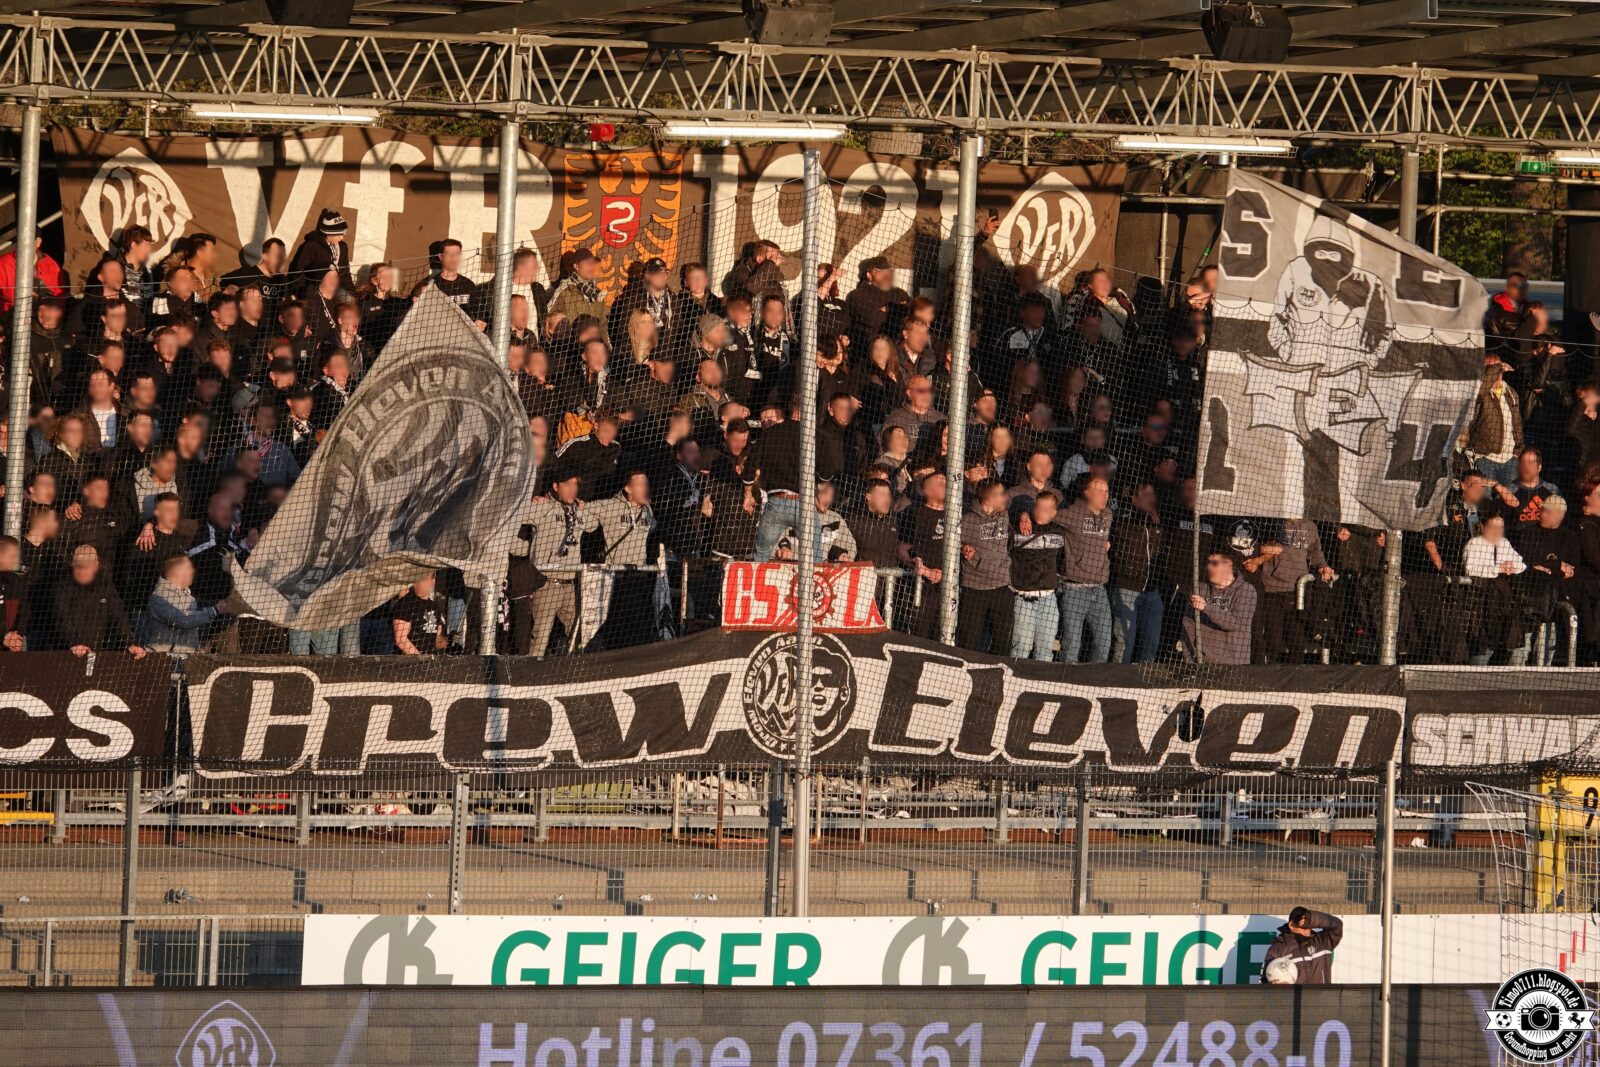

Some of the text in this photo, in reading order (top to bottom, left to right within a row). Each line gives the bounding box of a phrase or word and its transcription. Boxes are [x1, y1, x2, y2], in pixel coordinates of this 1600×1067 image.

[205, 135, 554, 290] VfR
[869, 645, 1404, 780] Eleven
[491, 929, 823, 985] GEIGER
[1021, 930, 1334, 985] GEIGE
[478, 1017, 752, 1067] Hotline
[776, 1021, 983, 1067] 07361
[1070, 1020, 1352, 1067] 52488-0
